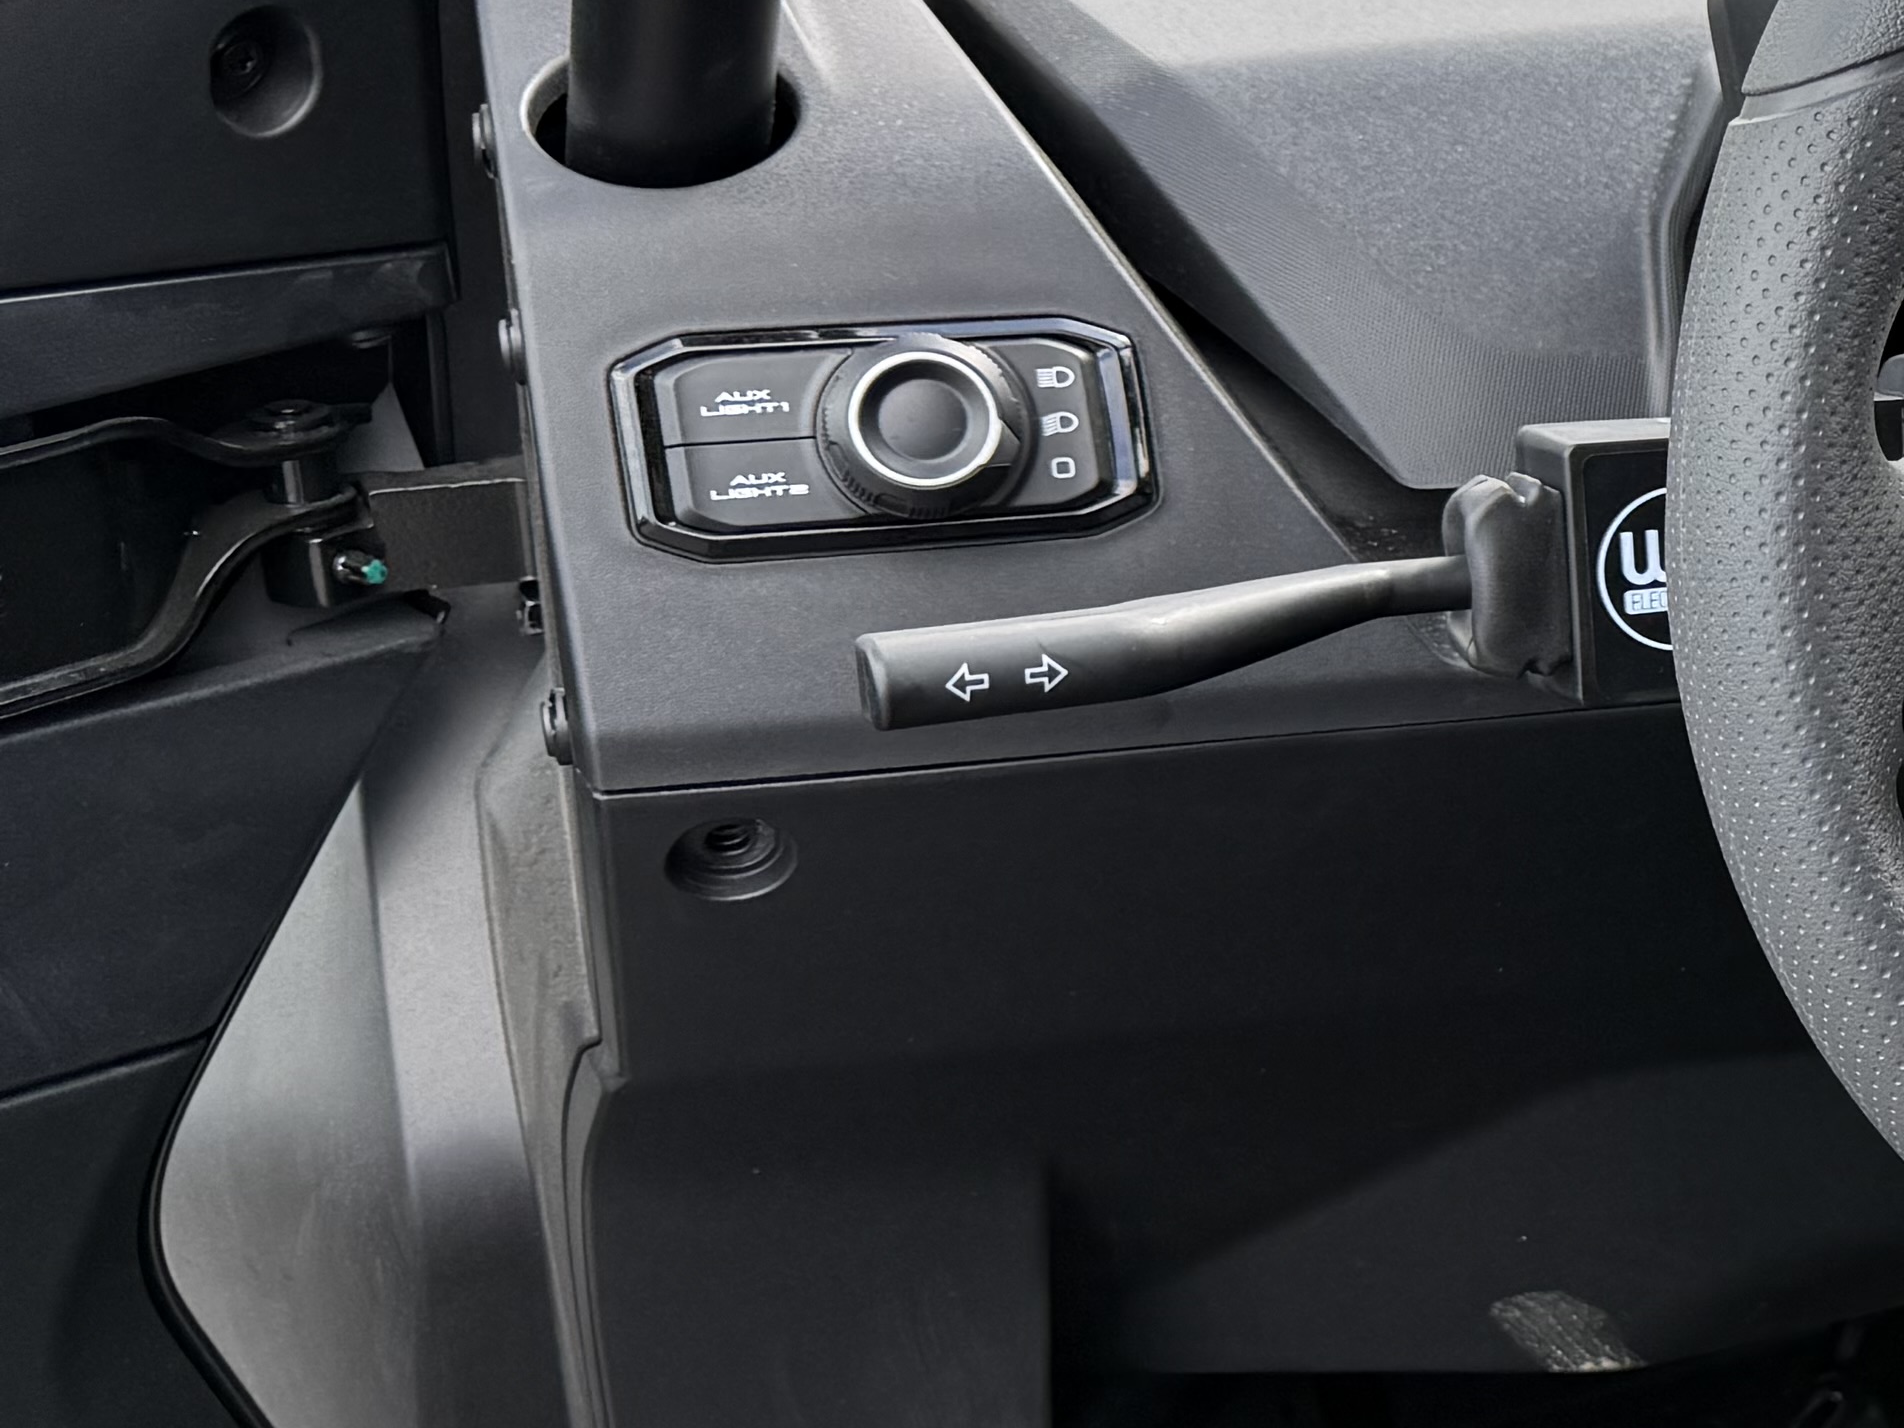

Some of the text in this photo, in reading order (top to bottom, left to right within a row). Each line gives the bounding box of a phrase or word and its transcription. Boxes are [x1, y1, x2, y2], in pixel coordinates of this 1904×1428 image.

[714, 389, 772, 403] AUX
[700, 401, 790, 417] LIGHT1
[729, 471, 787, 487] AUX
[709, 484, 810, 501] LIGHT2
